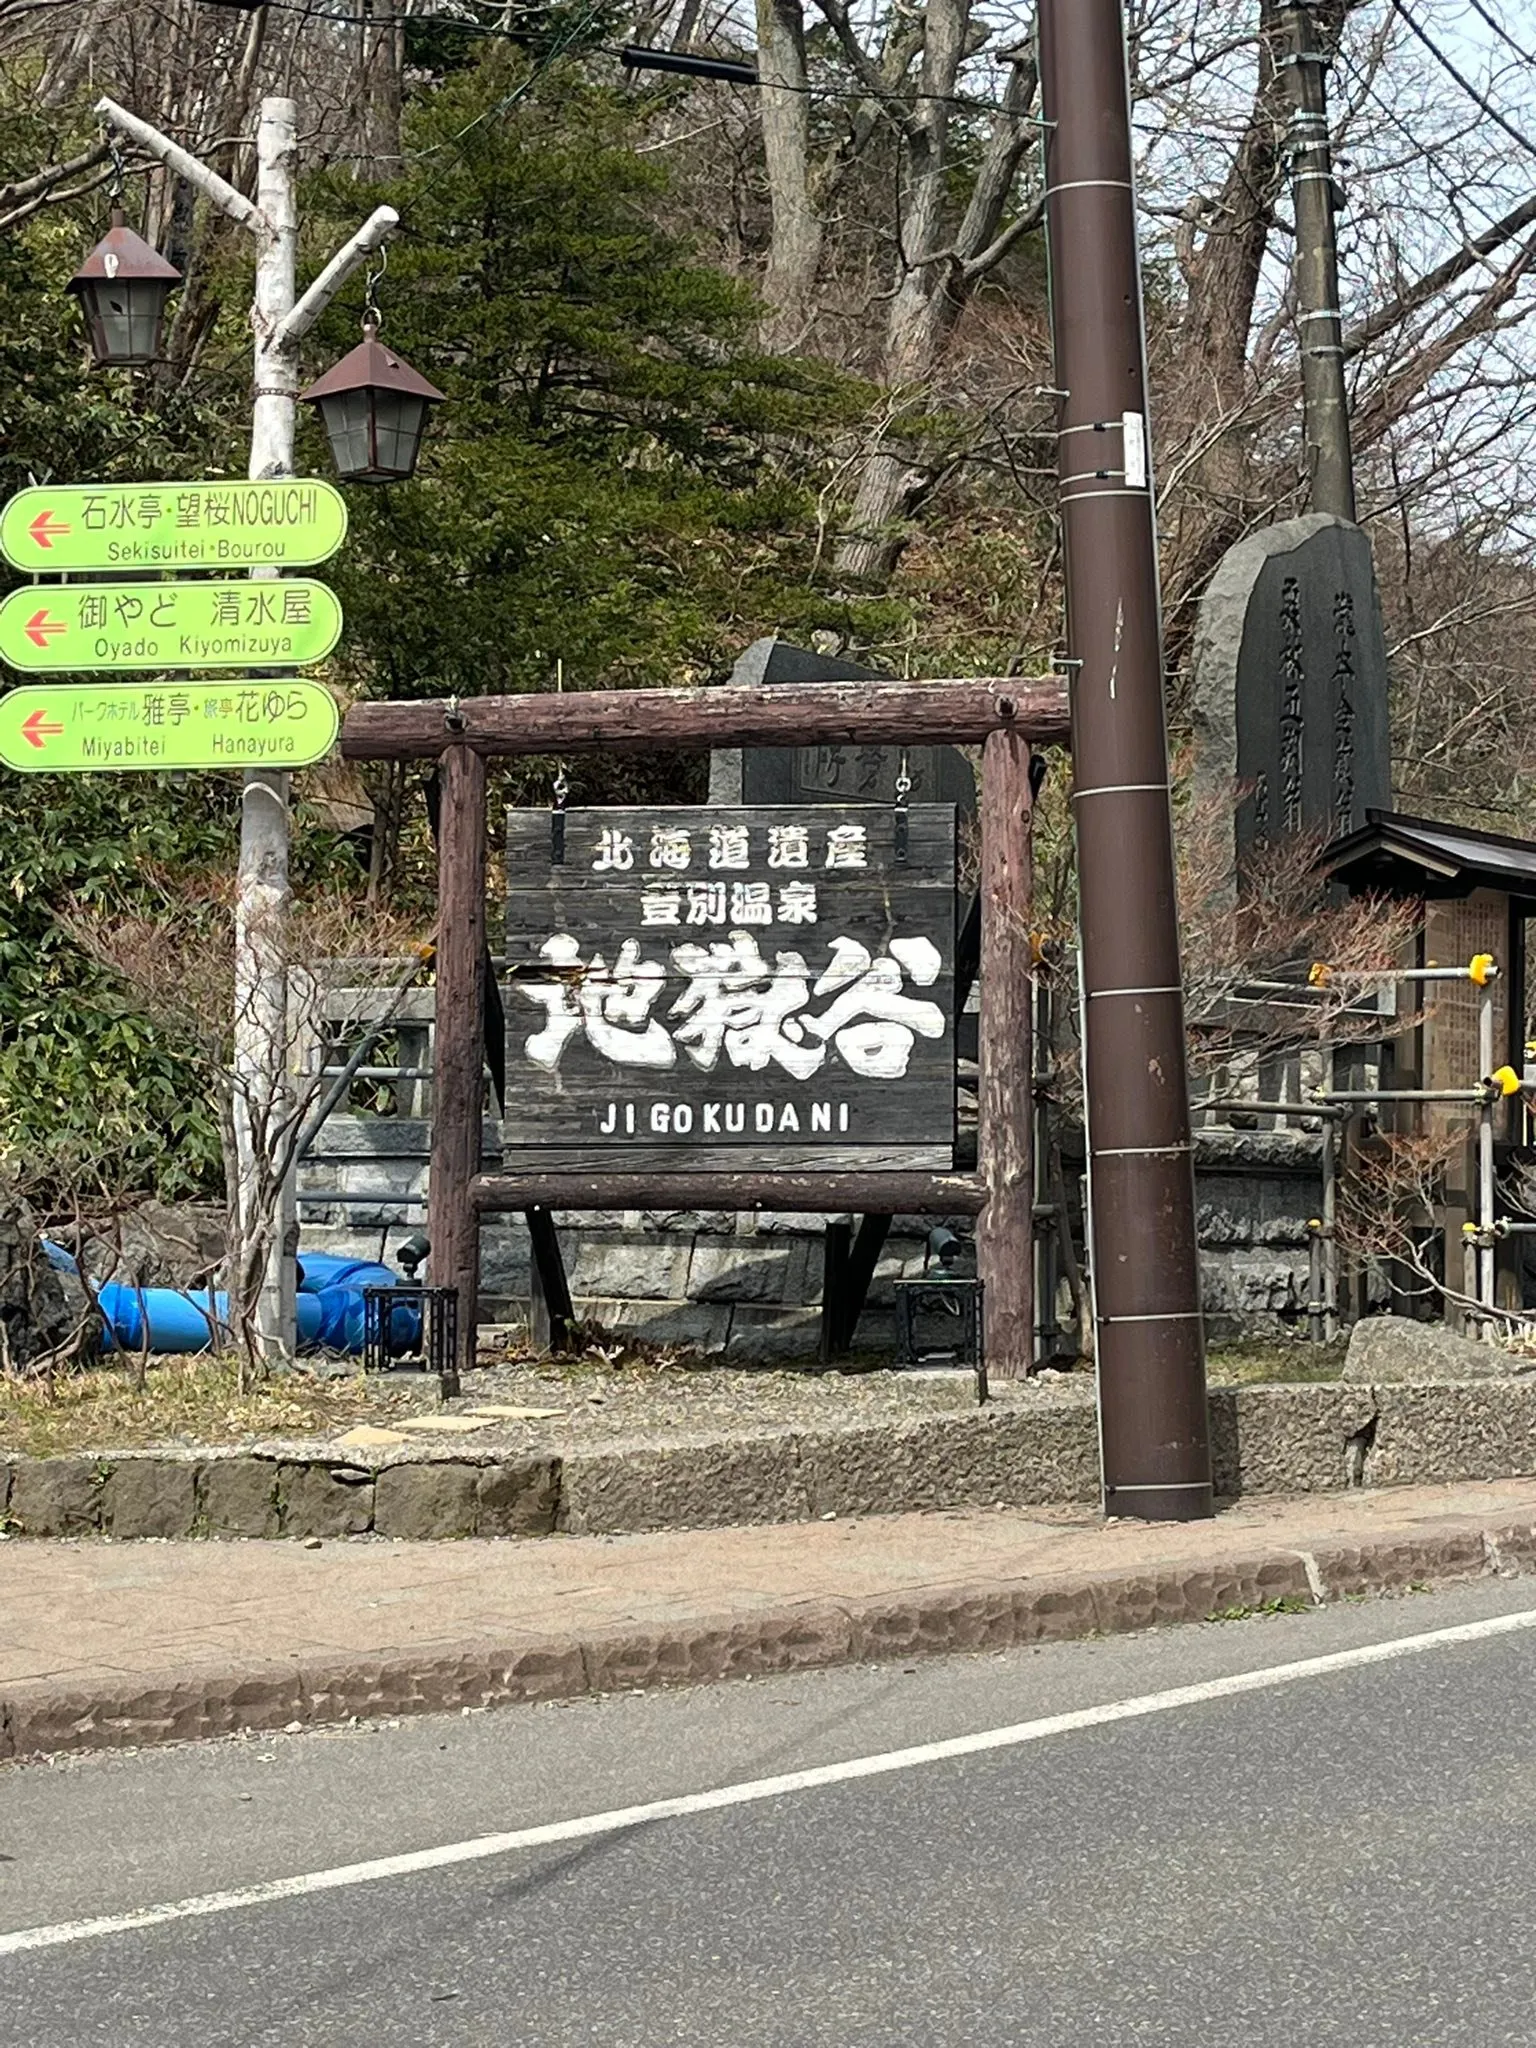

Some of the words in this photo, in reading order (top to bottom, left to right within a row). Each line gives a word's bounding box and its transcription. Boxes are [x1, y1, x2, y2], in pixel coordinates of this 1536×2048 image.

[77, 592, 178, 630] 御やど
[210, 589, 312, 627] 清水屋
[94, 637, 159, 662] Oyado
[179, 634, 292, 657] Kiyomizuya
[82, 734, 166, 761] Miyabitei
[212, 733, 295, 757] Hanayura
[591, 824, 869, 871] 北海道遺産
[512, 929, 947, 1081] 地獄谷
